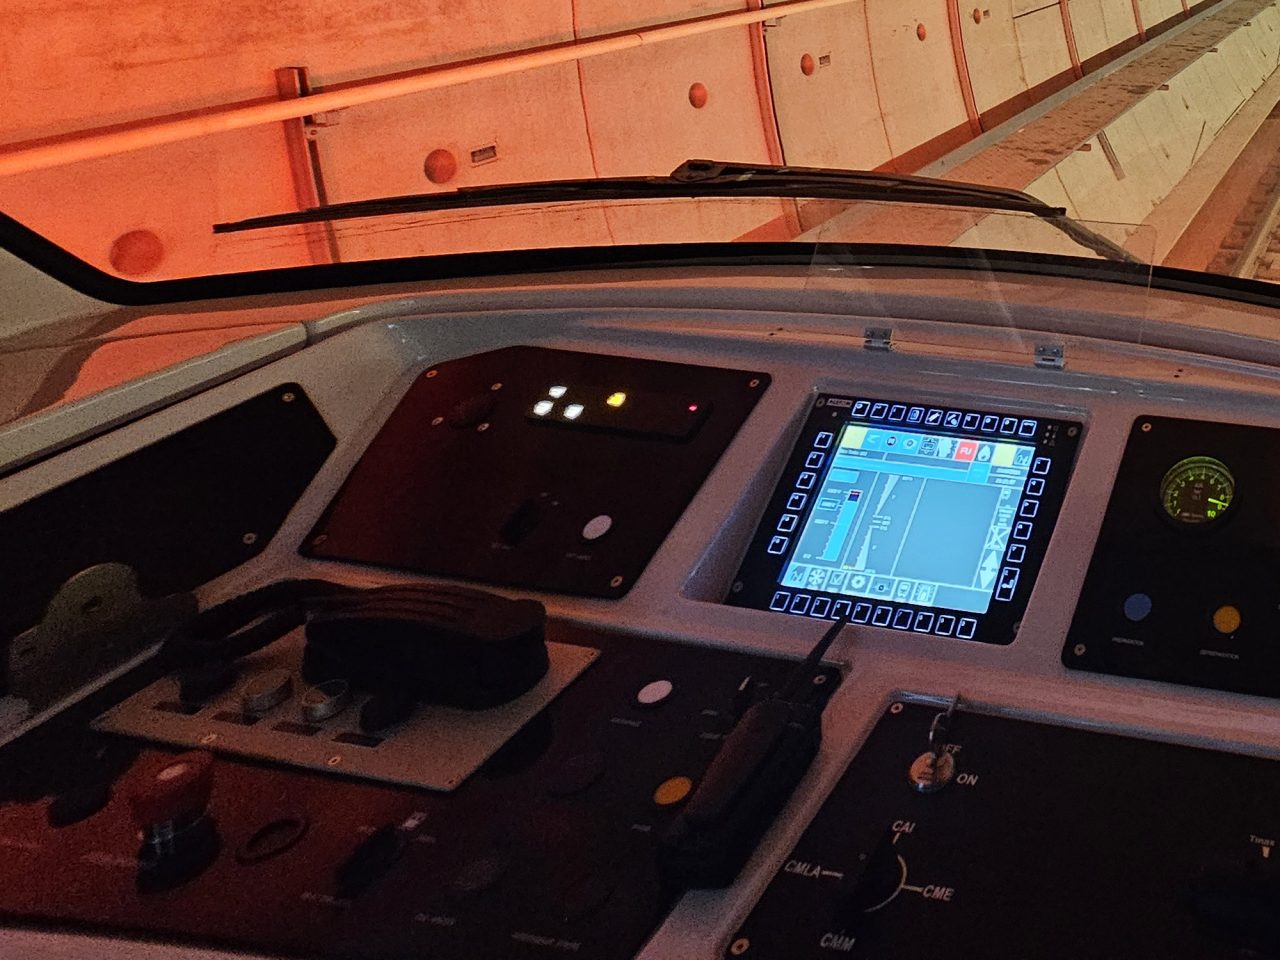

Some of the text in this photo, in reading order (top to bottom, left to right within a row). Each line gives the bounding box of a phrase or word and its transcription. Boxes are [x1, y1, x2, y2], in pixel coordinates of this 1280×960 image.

[956, 773, 979, 787] ON
[891, 819, 917, 834] CAI
[783, 860, 822, 880] CMLA
[921, 884, 956, 903] CME
[819, 931, 857, 952] CMM
